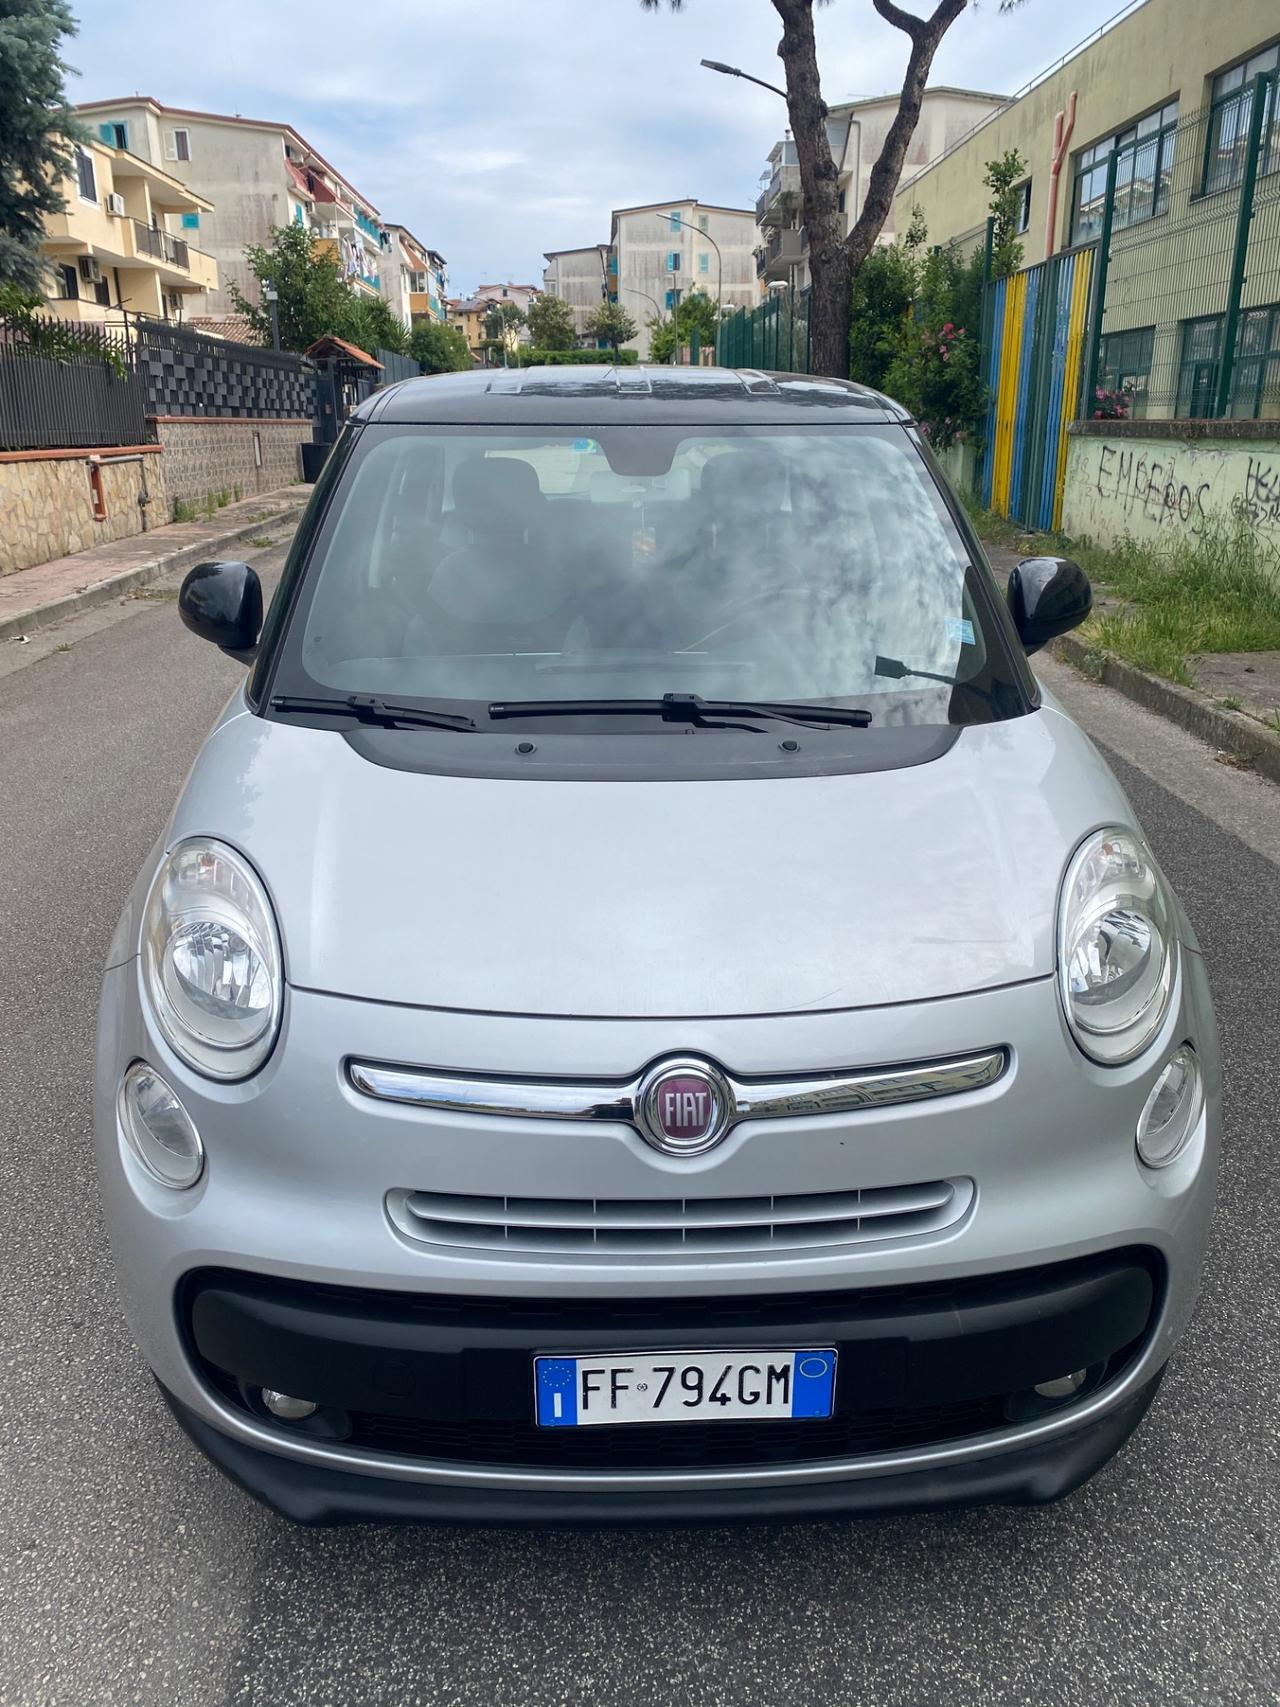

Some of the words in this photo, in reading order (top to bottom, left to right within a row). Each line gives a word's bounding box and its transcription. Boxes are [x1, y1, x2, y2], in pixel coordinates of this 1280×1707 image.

[665, 1093, 707, 1127] FIAT
[581, 1368, 634, 1410] FF
[652, 1364, 791, 1408] 794GM
